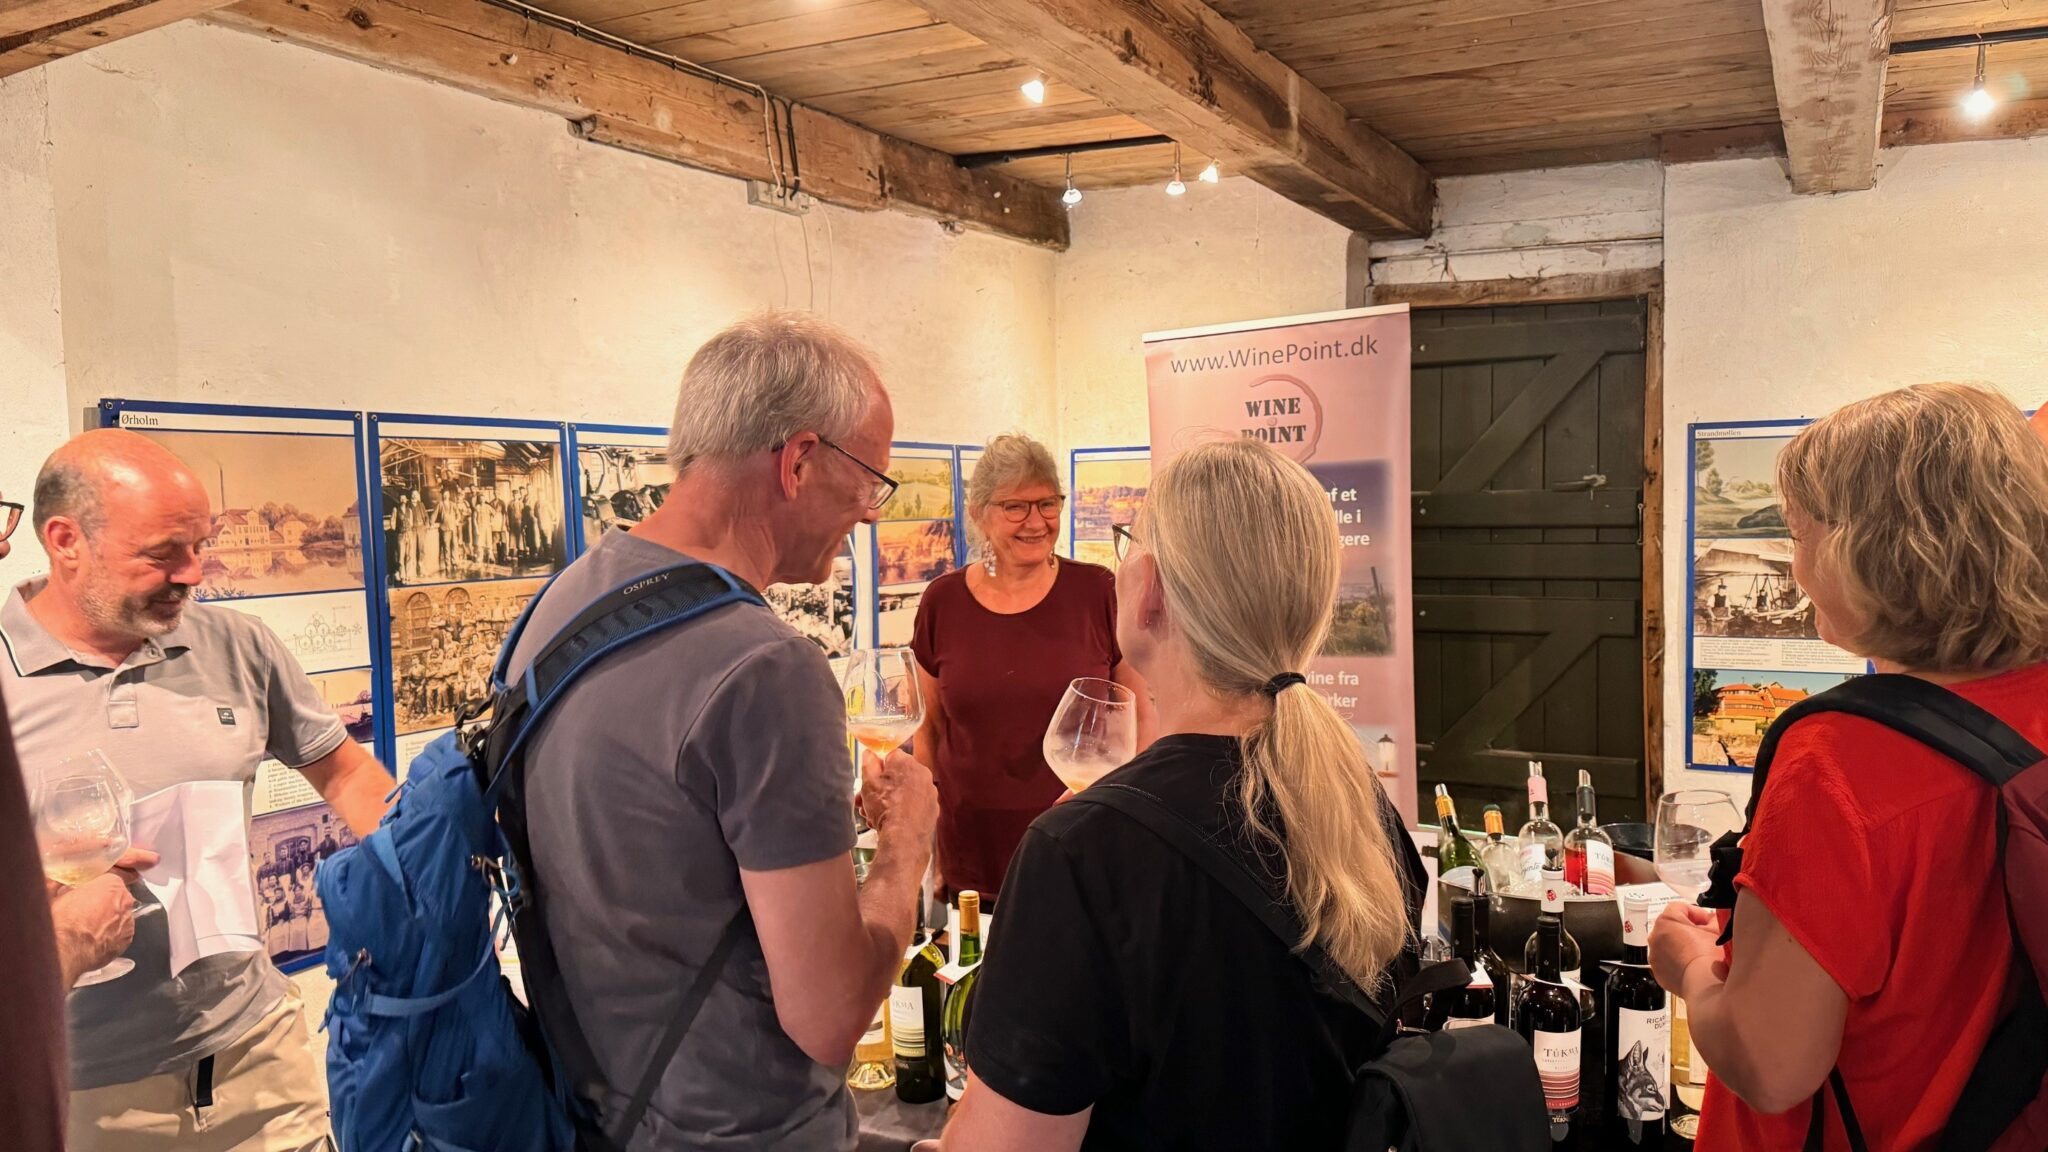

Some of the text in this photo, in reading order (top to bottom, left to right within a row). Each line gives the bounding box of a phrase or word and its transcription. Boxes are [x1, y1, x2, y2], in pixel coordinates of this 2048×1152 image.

[1171, 335, 1378, 373] www.WinePoint.dk
[1245, 397, 1301, 417] WINE
[121, 414, 159, 426] Ørholm
[1341, 488, 1357, 502] et
[1334, 509, 1362, 524] lle i
[1338, 535, 1370, 549] gere
[623, 572, 670, 595] OSPREY
[1338, 670, 1359, 685] fra
[1328, 692, 1358, 707] rker
